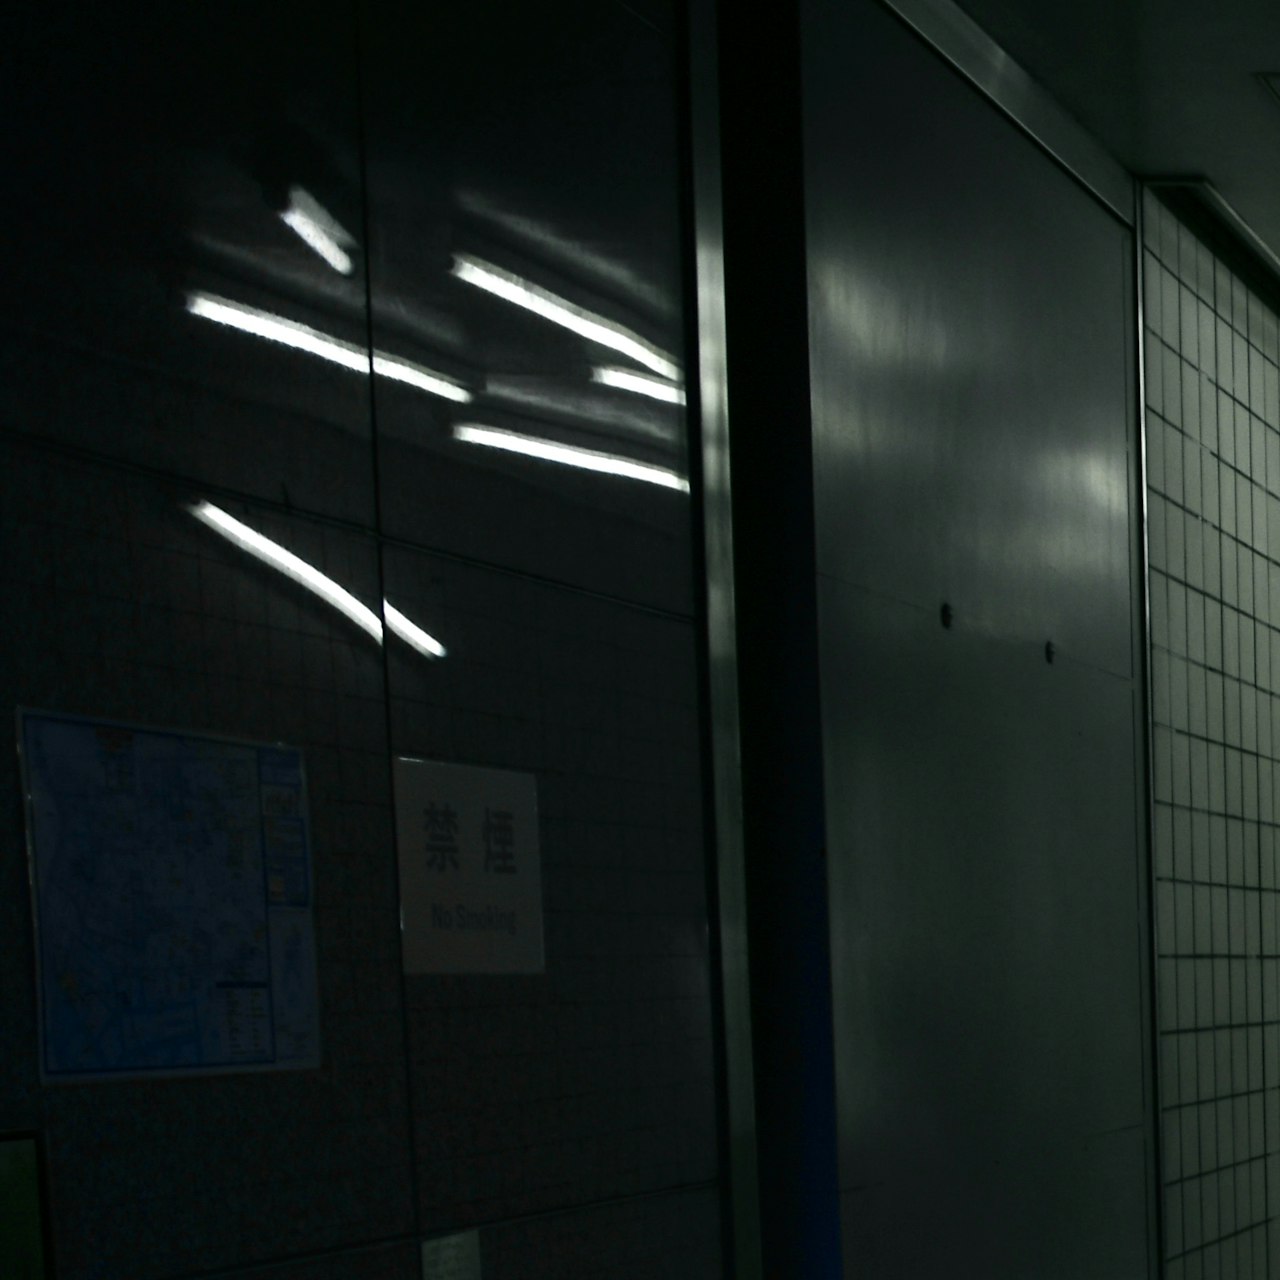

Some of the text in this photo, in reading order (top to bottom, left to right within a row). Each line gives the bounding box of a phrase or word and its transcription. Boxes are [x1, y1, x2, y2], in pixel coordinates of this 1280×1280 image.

[422, 801, 517, 874] 禁煙
[431, 902, 517, 935] No Smoking
